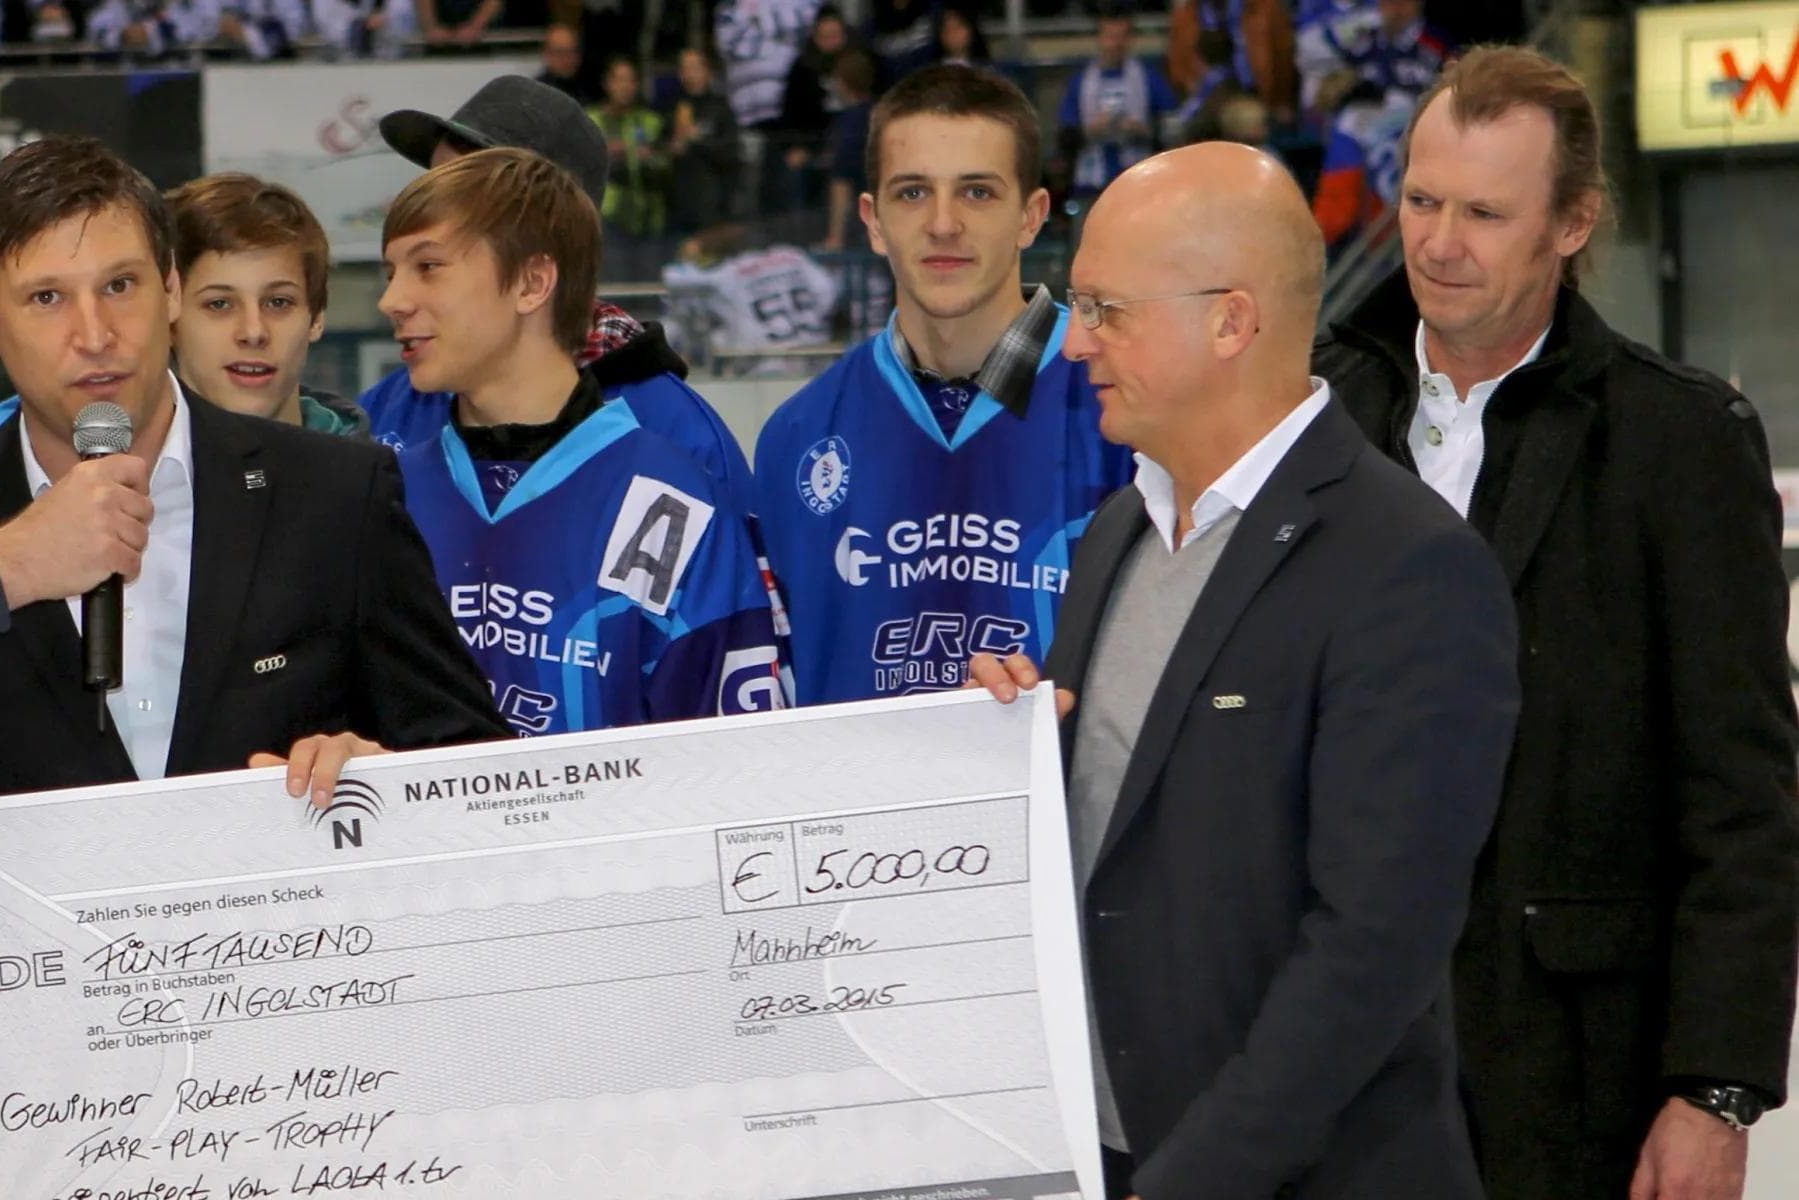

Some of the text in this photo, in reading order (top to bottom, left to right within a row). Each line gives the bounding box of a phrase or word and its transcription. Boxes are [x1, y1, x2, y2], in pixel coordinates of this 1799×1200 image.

[608, 492, 690, 606] A
[886, 514, 1021, 555] GEISS
[450, 582, 555, 626] EISS
[872, 610, 1031, 664] ERC
[404, 758, 644, 803] NATIONAL-BANK
[466, 789, 585, 813] Aktiengesellschaft
[332, 818, 363, 850] N
[504, 811, 550, 826] ESSEN
[802, 823, 844, 838] Betrag
[725, 828, 784, 846] Währung
[731, 844, 990, 903] € 5.000,00
[77, 884, 325, 924] Zahlen Sie gegen diesen Scheck
[730, 926, 879, 966] Mannheim
[83, 971, 236, 999] Betrag in Buchstaben
[729, 969, 750, 982] Ort
[117, 973, 415, 1027] ERC INGOLSTADT
[740, 983, 907, 1020] 07.03.2015
[86, 1025, 106, 1037] an
[88, 1026, 214, 1053] oder Überbringer
[735, 1022, 777, 1037] Datum
[0, 1091, 153, 1131] Gewinner
[744, 1113, 818, 1132] Unterschrift
[228, 1178, 279, 1200] von
